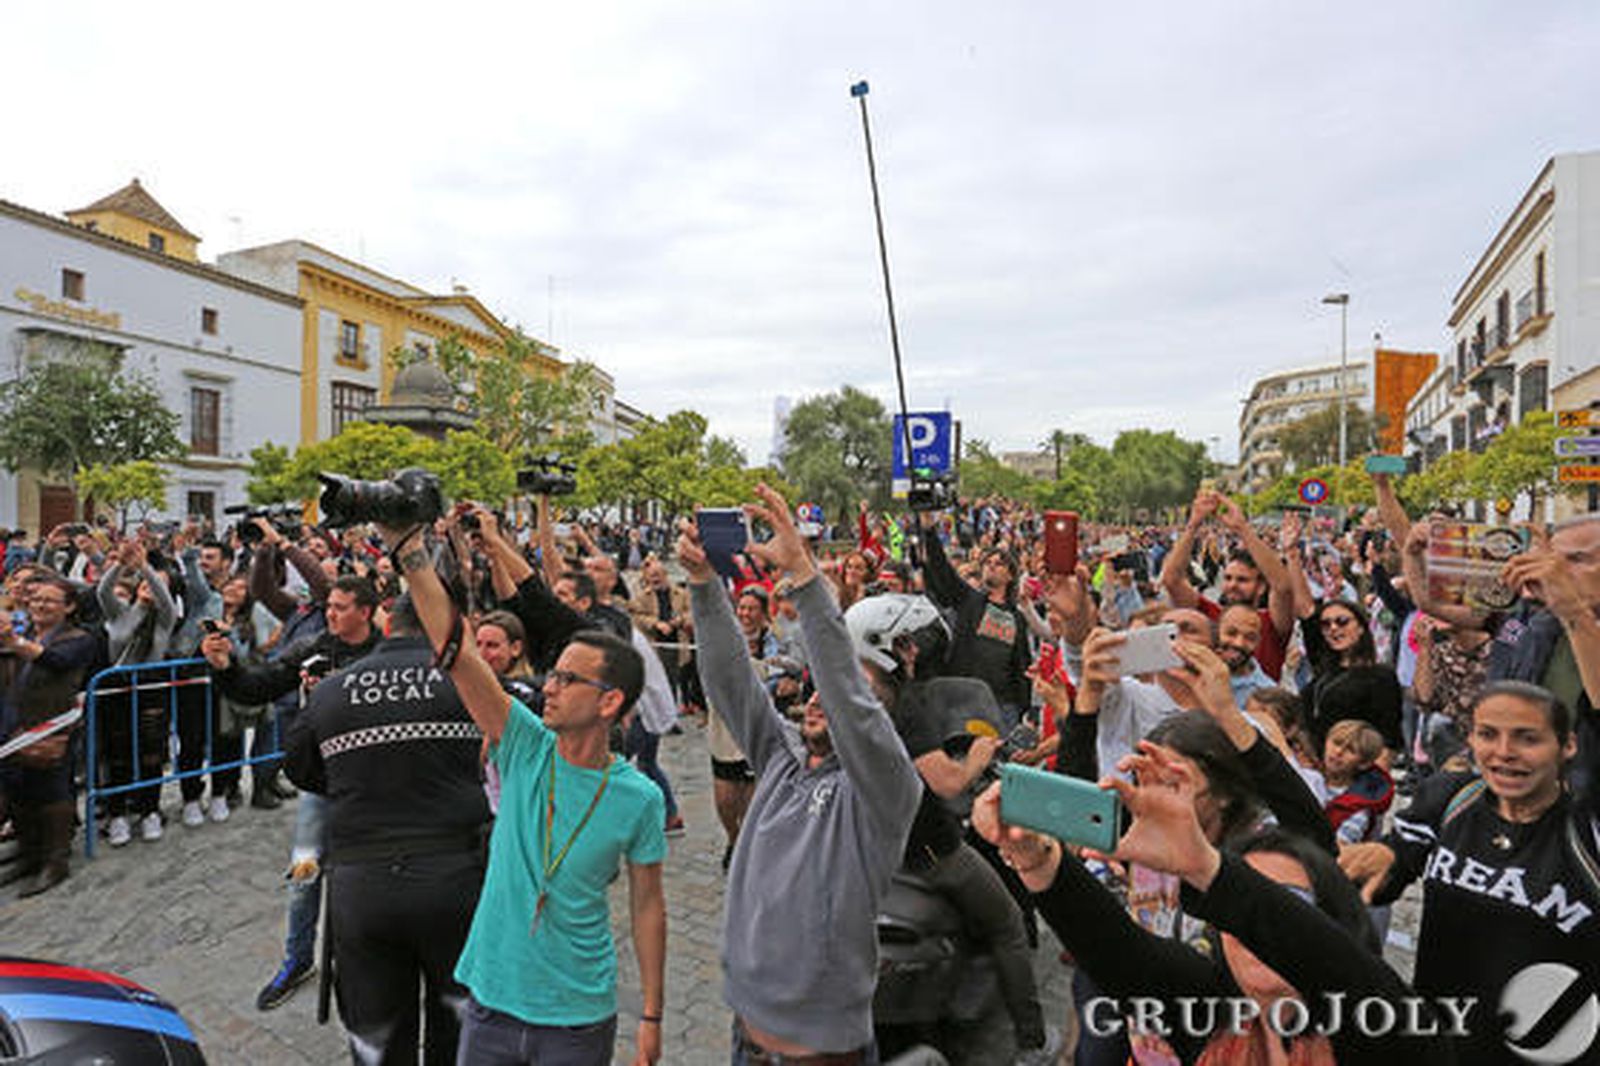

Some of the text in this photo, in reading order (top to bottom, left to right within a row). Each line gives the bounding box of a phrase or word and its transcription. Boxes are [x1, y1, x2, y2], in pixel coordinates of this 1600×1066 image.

[902, 417, 937, 466] P
[343, 667, 443, 688] POLICIA
[351, 684, 435, 704] LOCAL
[1422, 846, 1593, 934] REAM
